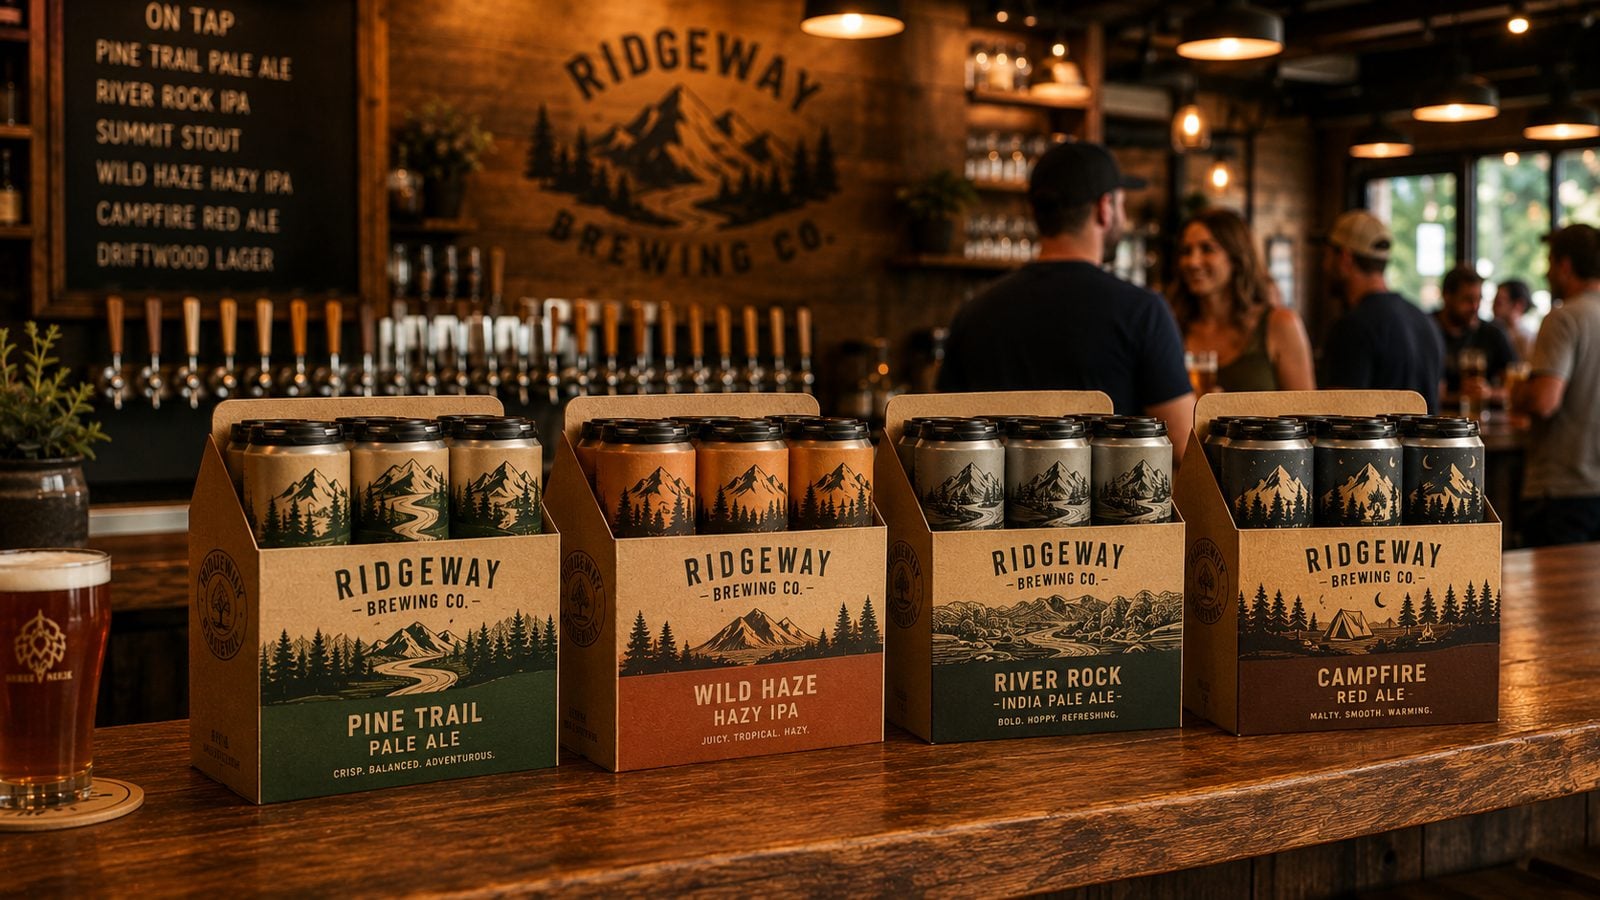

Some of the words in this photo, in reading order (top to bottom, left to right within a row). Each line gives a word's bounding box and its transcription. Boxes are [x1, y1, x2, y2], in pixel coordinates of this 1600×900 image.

[145, 2, 181, 32] ON
[190, 8, 235, 36] TAP
[96, 39, 143, 67] PINE
[149, 44, 203, 73] TRAIL
[208, 49, 253, 78] PALE
[258, 55, 293, 81] ALE
[565, 27, 821, 112] RIDGEWAY
[96, 79, 154, 108] RIVER
[161, 85, 214, 112] ROCK
[221, 90, 251, 115] IPA
[96, 119, 174, 148] SUMMIT
[181, 125, 242, 152] STOUT
[96, 160, 147, 187] WILD
[154, 163, 202, 190] HAZE
[211, 168, 260, 193] HAZY
[265, 171, 293, 195] IPA
[96, 201, 196, 230] CAMPFIRE
[203, 205, 240, 231] RED
[246, 209, 280, 233] ALE
[96, 242, 209, 270] DRIFTWOOD
[216, 246, 274, 272] LAGER
[549, 208, 751, 277] BREWING
[772, 220, 836, 262] CO.
[684, 546, 831, 586] RIDGEWAY
[992, 541, 1125, 576] RIDGEWAY
[1305, 539, 1442, 573] RIDGEWAY
[335, 556, 501, 601] RIDGEWAY
[713, 580, 776, 602] BREWING
[783, 580, 803, 595] CO.
[1017, 572, 1074, 590] BREWING
[1080, 572, 1099, 586] CO.
[1331, 570, 1391, 588] BREWING
[1397, 571, 1416, 585] CO.
[367, 595, 439, 617] BREWING
[446, 593, 469, 609] CO.
[694, 680, 751, 706] WILD
[762, 673, 818, 700] HAZE
[994, 669, 1058, 693] RIVER
[1068, 665, 1122, 688] ROCK
[1317, 663, 1427, 688] CAMPFIRE
[1048, 692, 1082, 707] PALE
[1337, 690, 1368, 704] RED
[1375, 688, 1405, 702] ALE
[348, 709, 405, 737] PINE
[414, 702, 483, 729] TRAIL
[713, 704, 762, 726] HAZY
[770, 702, 798, 721] IPA
[998, 717, 1024, 727] BOLD.
[1027, 714, 1059, 724] HOPPY.
[1062, 710, 1119, 722] REFRESHING.
[1310, 710, 1342, 720] MALTY.
[1345, 708, 1385, 719] SMOOTH.
[1388, 706, 1433, 717] WARMING.
[369, 735, 417, 757] PALE
[426, 731, 460, 749] ALE
[701, 733, 730, 745] JUICY.
[733, 729, 781, 743] TROPICAL.
[784, 725, 810, 737] HAZY.
[333, 765, 366, 778] CRISP.
[369, 758, 422, 775] BALANCED.
[425, 751, 496, 768] ADVENTUROUS.
